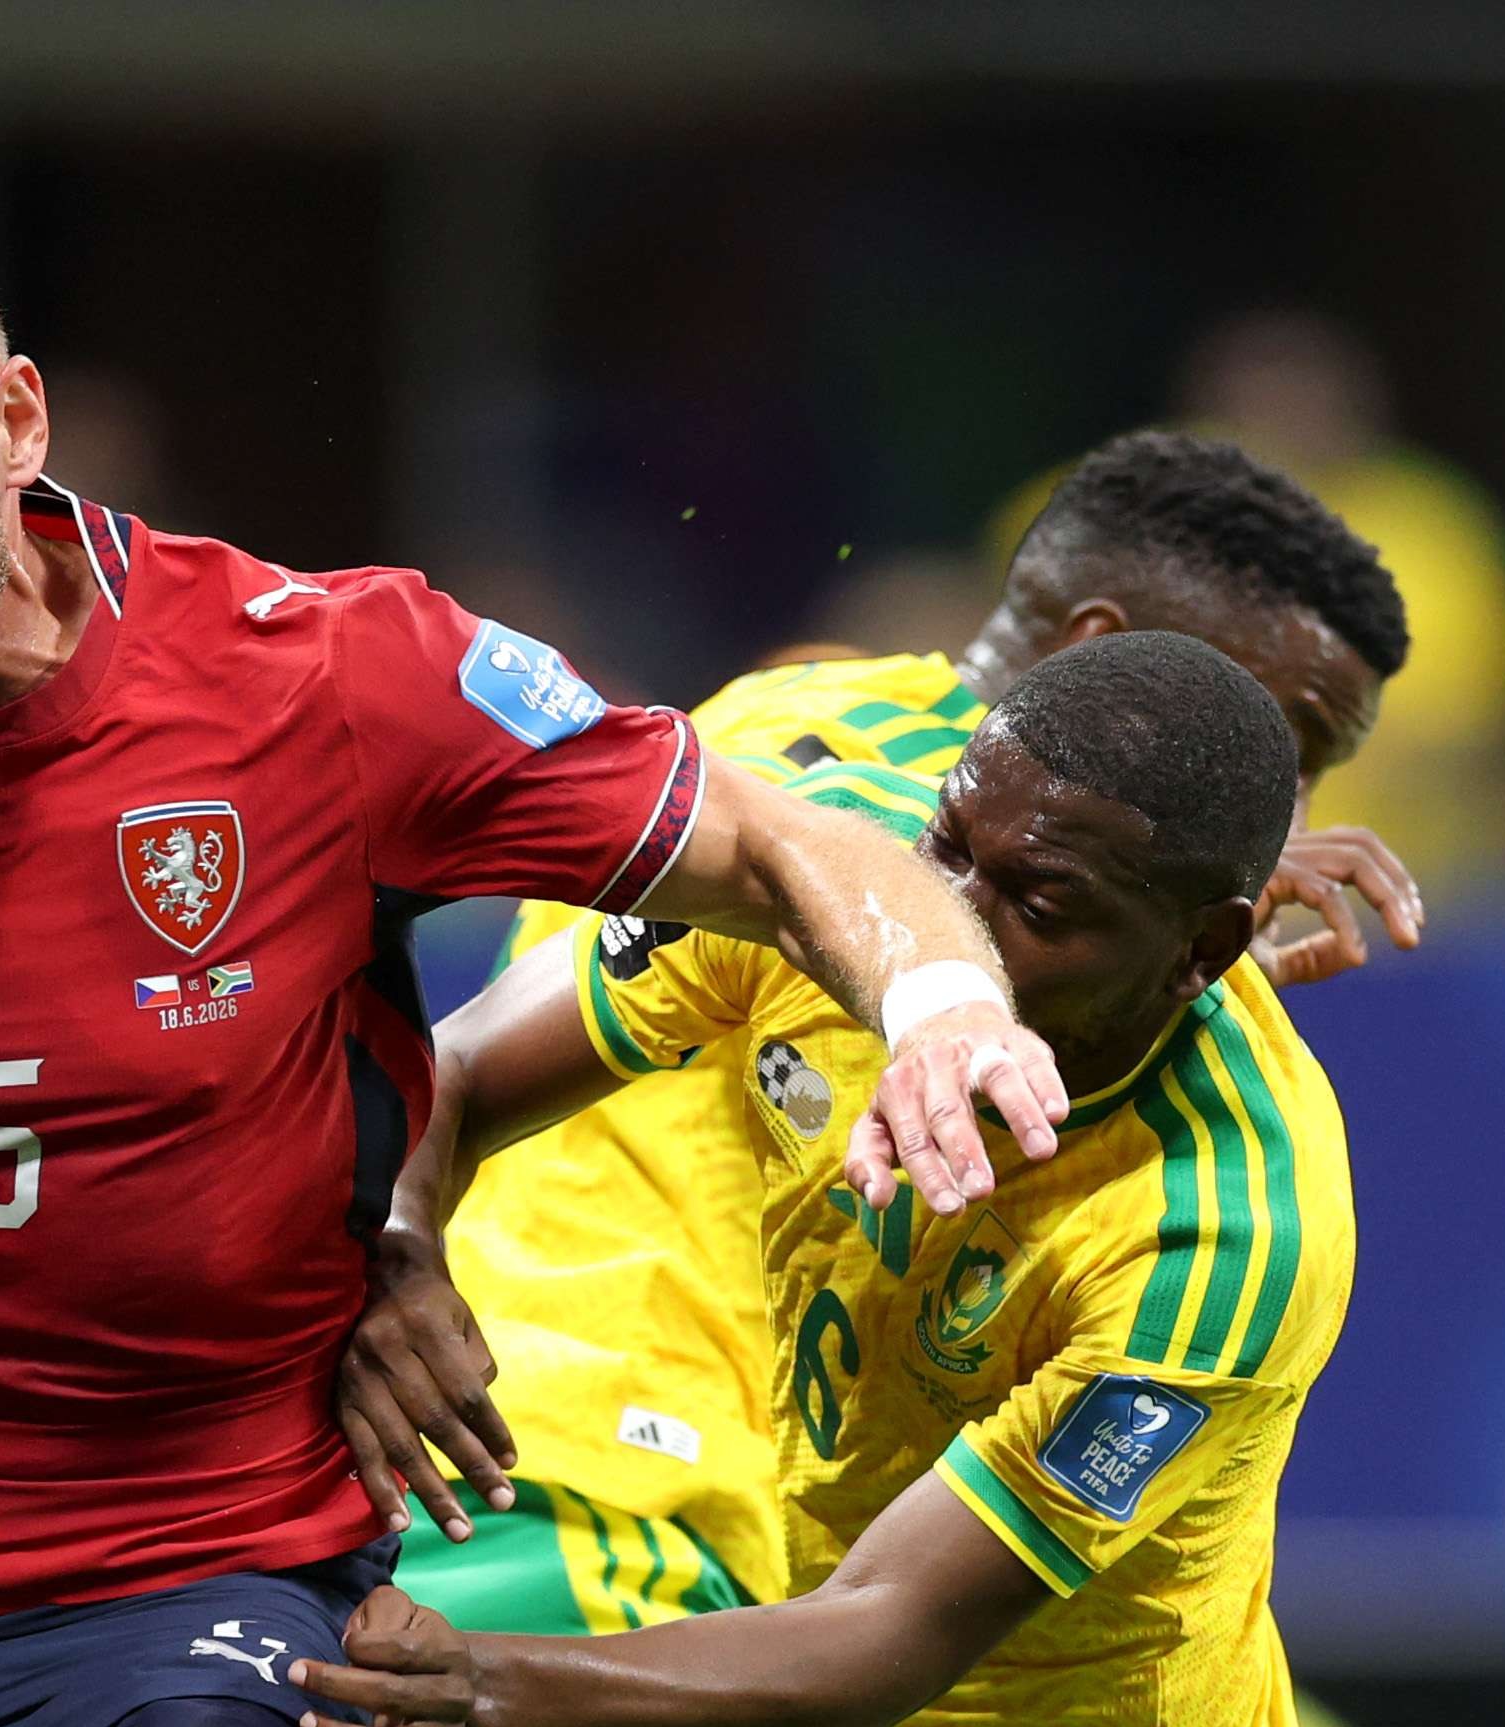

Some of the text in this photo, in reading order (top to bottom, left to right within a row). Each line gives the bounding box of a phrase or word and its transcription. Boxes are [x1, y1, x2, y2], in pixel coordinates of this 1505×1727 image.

[159, 998, 238, 1030] 18.6.2026
[794, 1288, 860, 1461] 6
[1093, 1418, 1134, 1454] Unite
[1081, 1441, 1136, 1487] PEACE
[1080, 1469, 1109, 1496] FIFA
